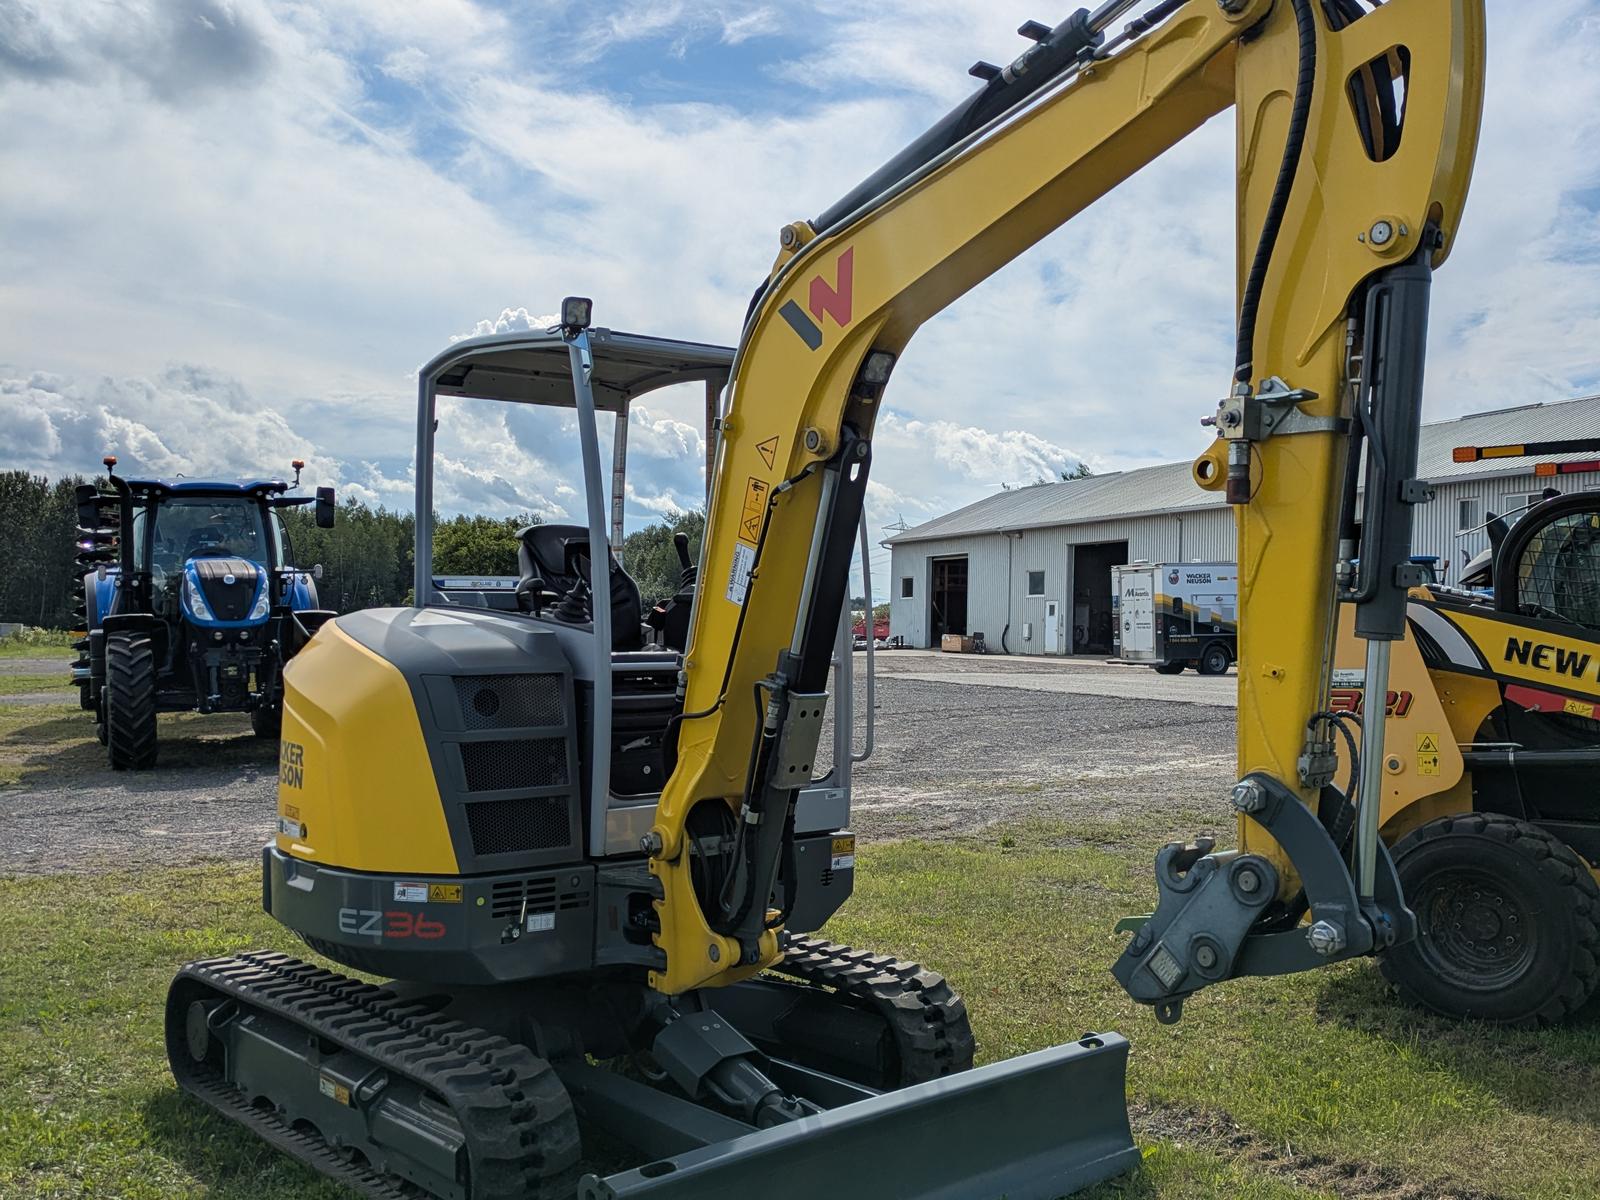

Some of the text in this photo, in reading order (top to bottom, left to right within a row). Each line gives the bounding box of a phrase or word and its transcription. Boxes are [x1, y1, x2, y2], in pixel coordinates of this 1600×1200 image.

[729, 551, 741, 585] WARNING
[1503, 637, 1592, 678] NEW
[338, 907, 446, 940] EZ36
